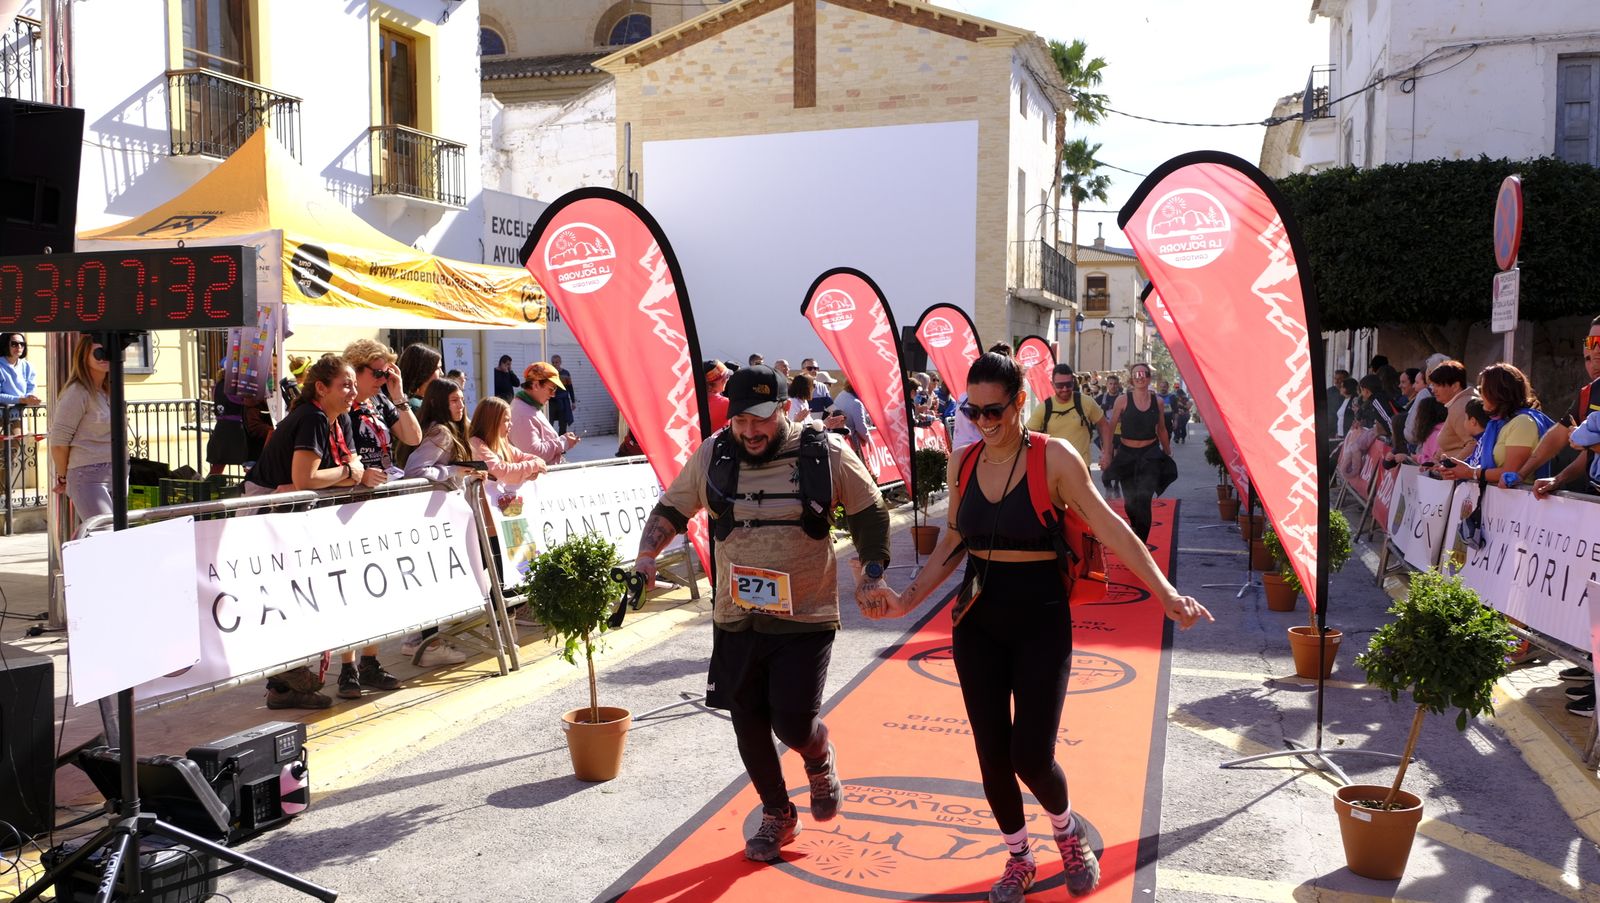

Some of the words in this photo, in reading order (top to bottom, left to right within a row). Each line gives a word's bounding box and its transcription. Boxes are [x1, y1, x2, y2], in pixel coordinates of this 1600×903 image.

[491, 216, 536, 239] EXCELE
[0, 254, 237, 324] 03:07:32
[540, 487, 647, 514] AYUNTAMIENTO
[542, 505, 656, 549] CANTOR
[208, 527, 421, 583] AYUNTAMIENTO
[430, 521, 454, 541] DE
[211, 546, 467, 634] CANTORIA
[738, 577, 776, 597] 271
[842, 791, 994, 819] POLVOR
[843, 785, 933, 801] Cantoria
